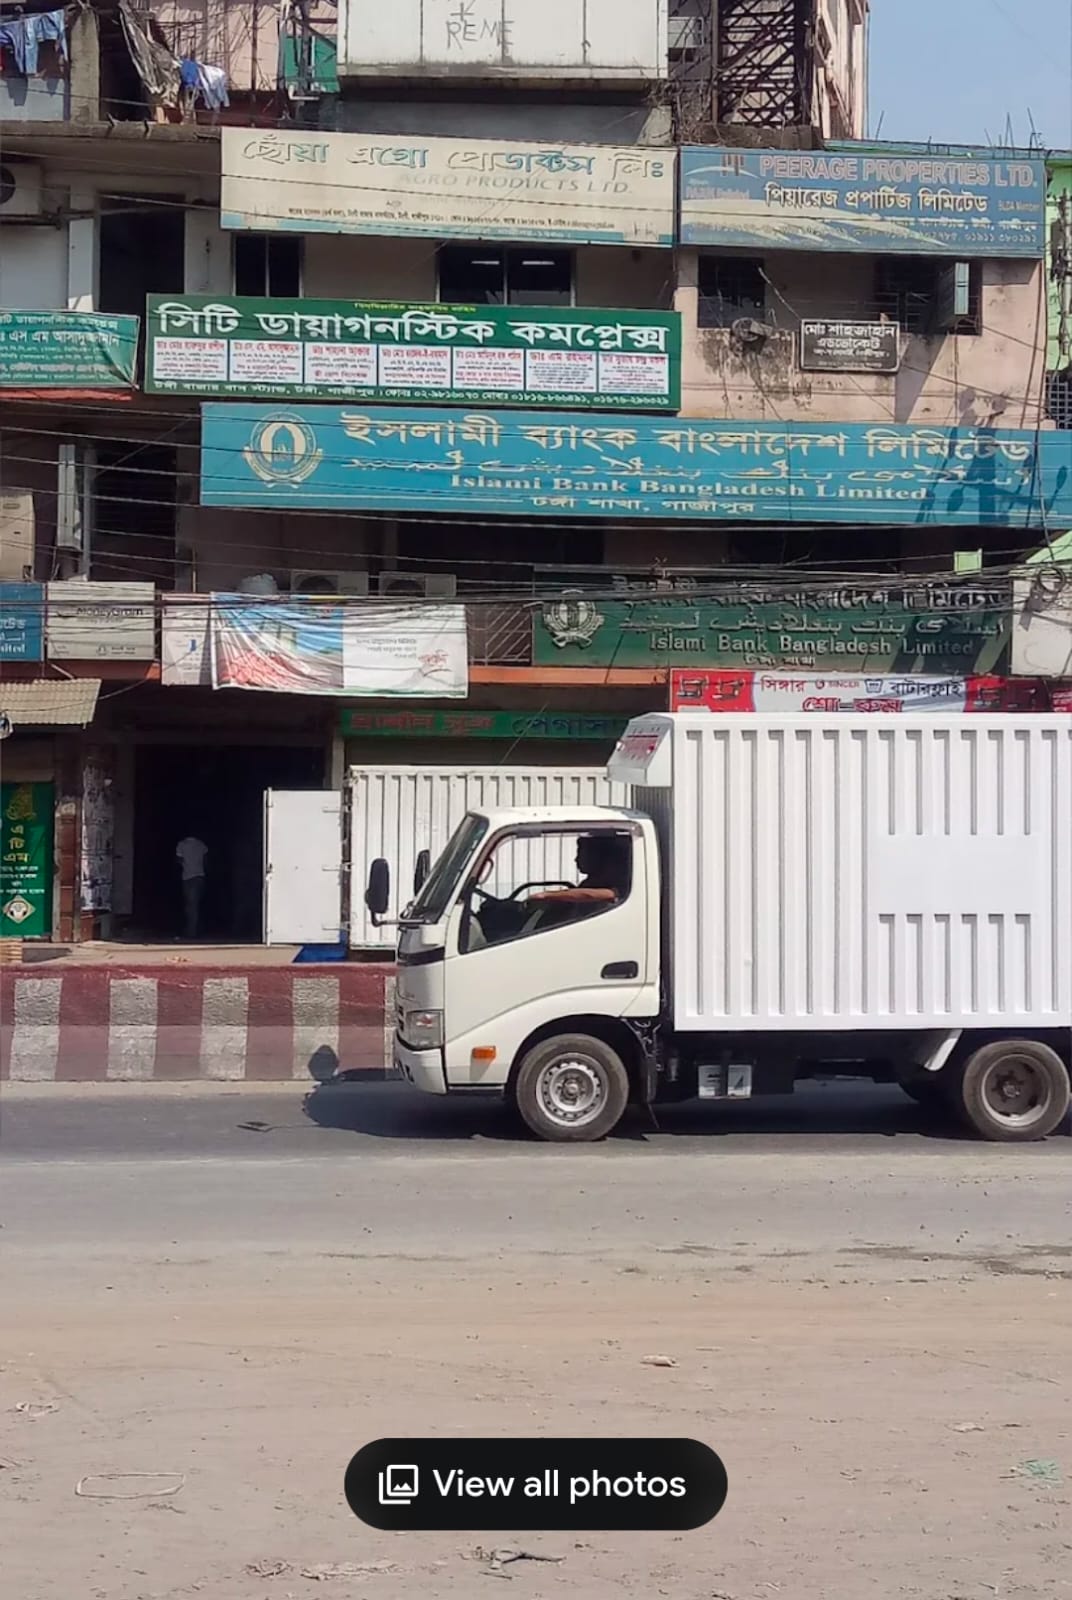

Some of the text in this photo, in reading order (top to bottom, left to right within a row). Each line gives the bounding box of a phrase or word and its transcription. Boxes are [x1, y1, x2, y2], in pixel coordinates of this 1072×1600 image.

[466, 175, 578, 192] PRODUCTS
[760, 155, 1038, 188] PEERAGE PROPERTIES LTD.
[764, 181, 839, 209] পিয়ারেজ
[845, 185, 912, 210] প্রপার্টিজ
[918, 187, 988, 212] লিমিটেড
[153, 302, 671, 351] সিটি ডায়াগনস্টিক কমপ্লেক্স
[340, 411, 1032, 461] ইসলামী ব্যাংক বাংলাদেশ লিমিটেড
[451, 474, 928, 499] Islami Bank Bangladesh Limited
[651, 633, 974, 655] Islami Bank Bangladesh Limited
[760, 675, 807, 693] সিঙ্গার
[889, 679, 964, 697] বাটারফ্লাই
